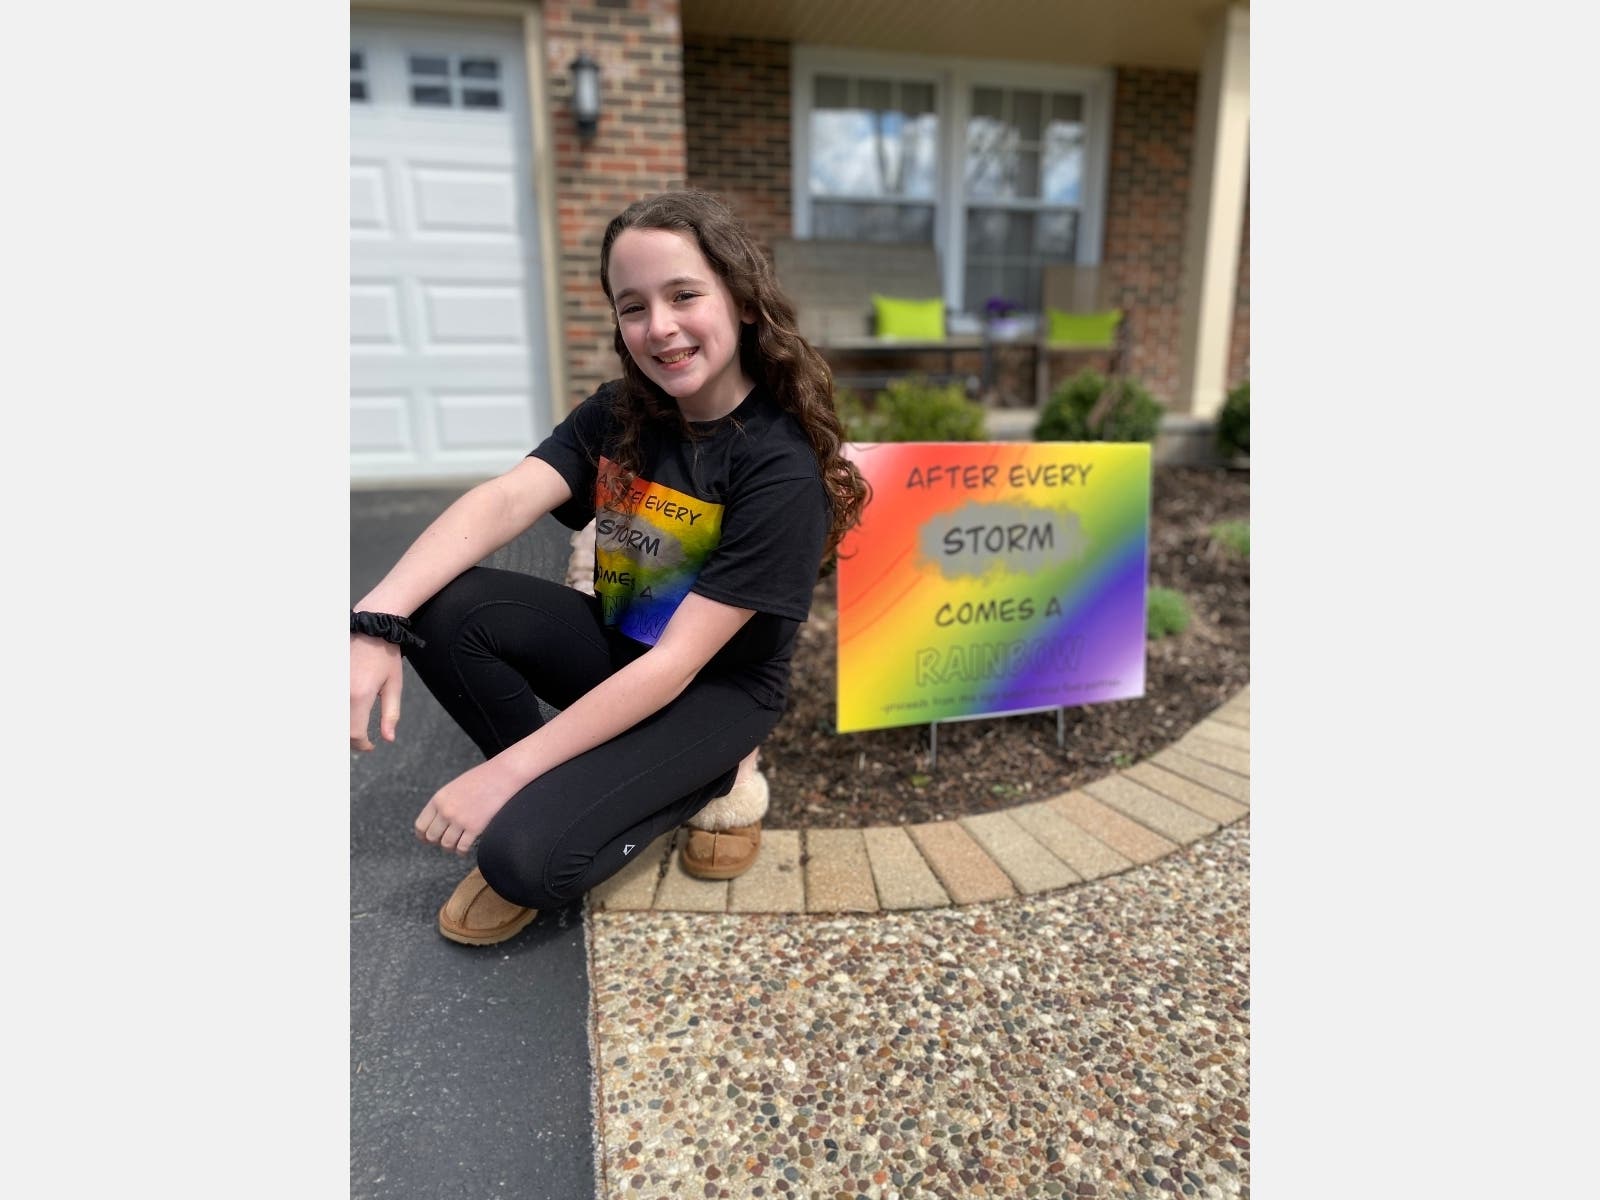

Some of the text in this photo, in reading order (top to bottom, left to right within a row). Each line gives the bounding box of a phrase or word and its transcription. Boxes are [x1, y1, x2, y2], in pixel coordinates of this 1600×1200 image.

[906, 463, 1093, 490] AFTER EVERY
[645, 495, 702, 526] EVERY
[597, 519, 660, 557] STORM
[943, 523, 1054, 555] STORM
[935, 597, 1062, 627] COMES A
[915, 634, 1084, 687] RAINBOW
